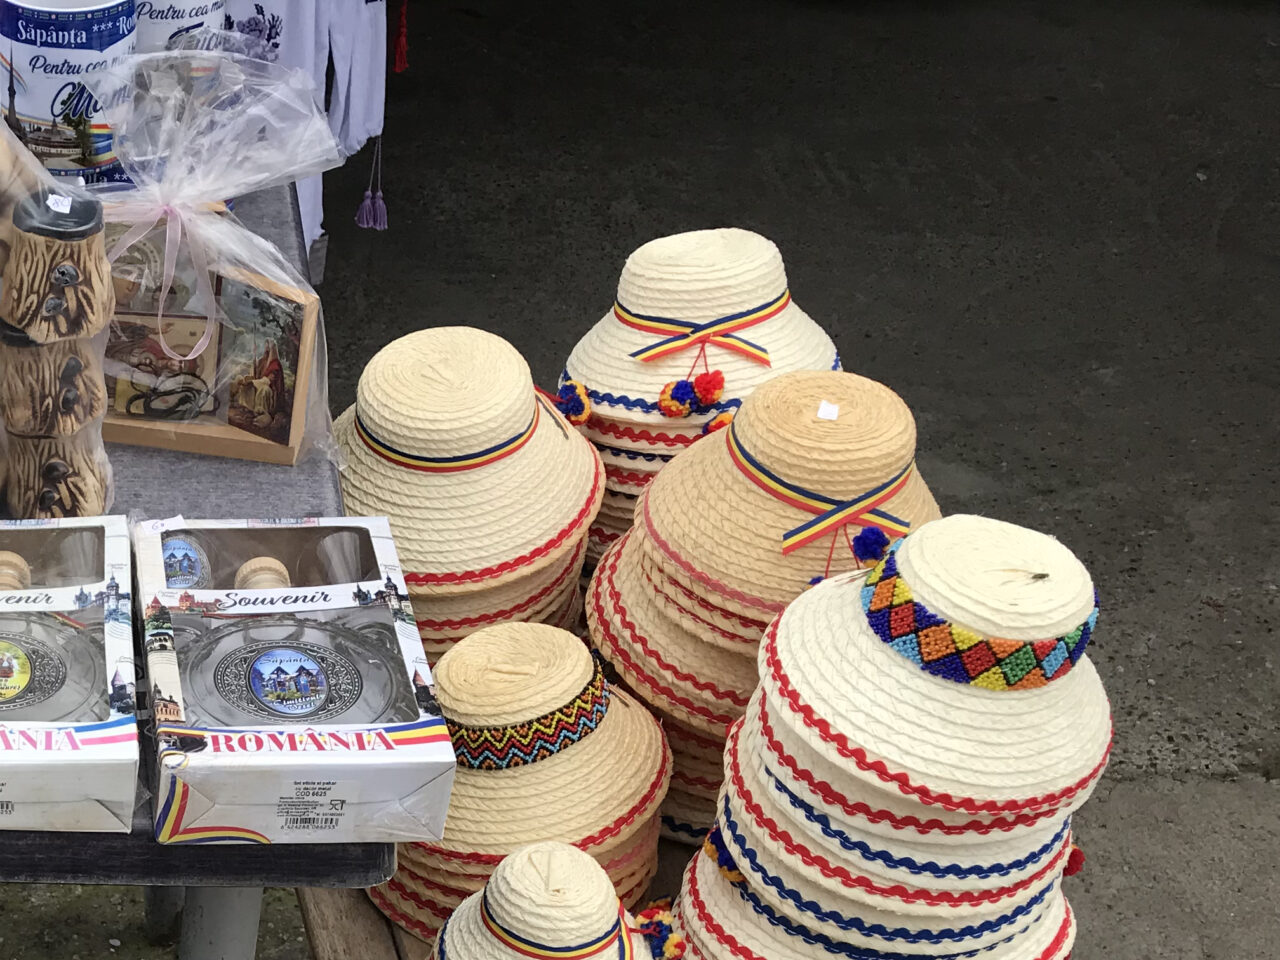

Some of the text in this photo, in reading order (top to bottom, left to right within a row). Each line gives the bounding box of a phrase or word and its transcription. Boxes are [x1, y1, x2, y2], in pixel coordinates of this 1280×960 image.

[137, 1, 209, 20] Pentru cea
[29, 54, 84, 75] Pentru
[218, 591, 332, 609] Souvenir
[208, 727, 397, 753] ROMÂNIA
